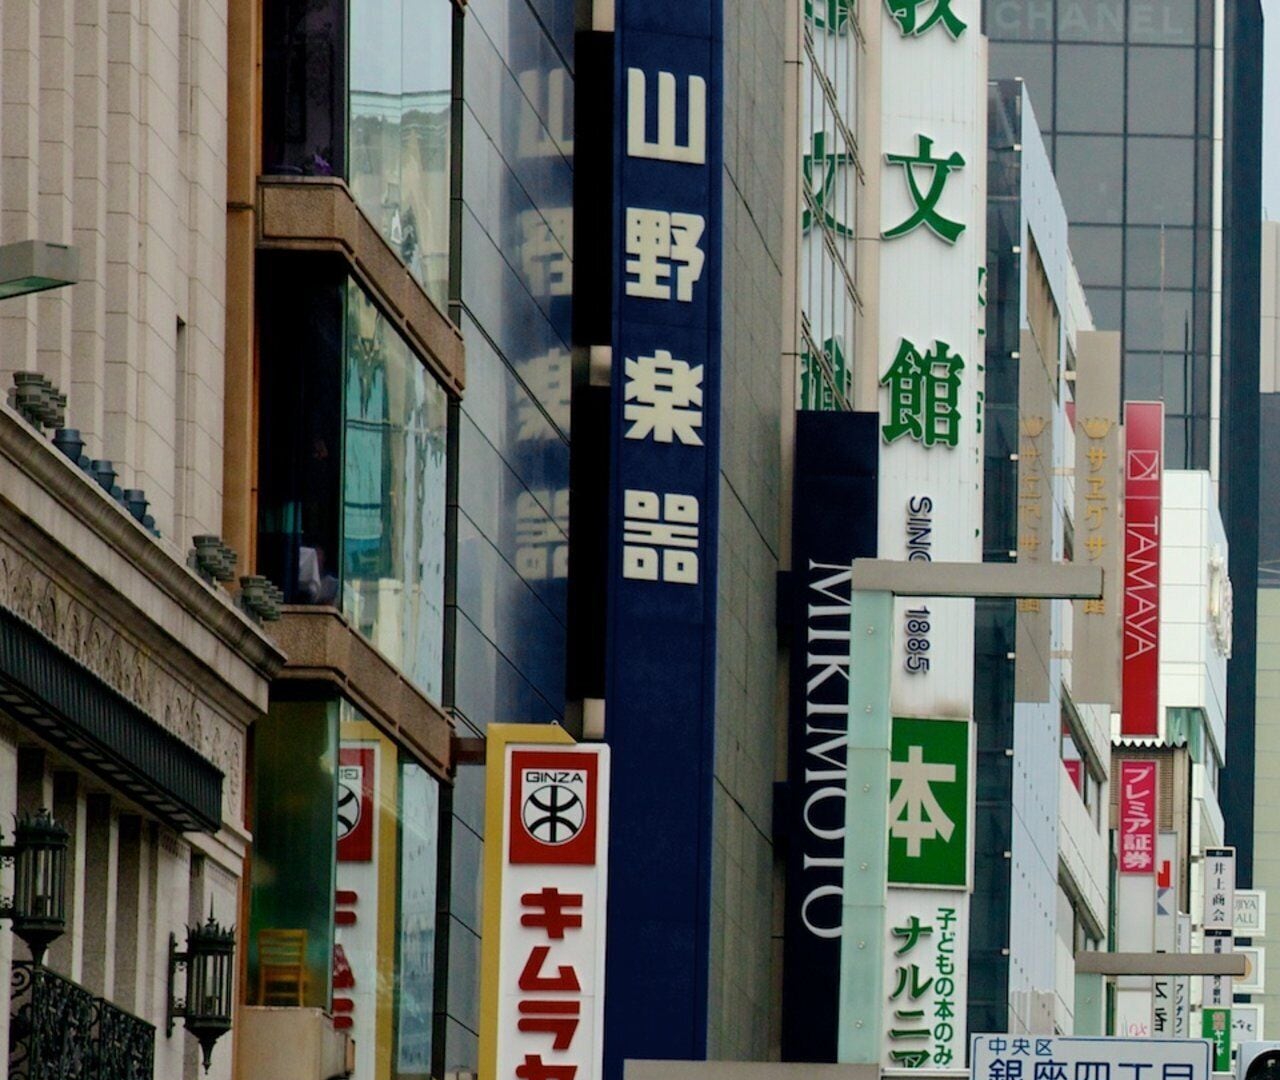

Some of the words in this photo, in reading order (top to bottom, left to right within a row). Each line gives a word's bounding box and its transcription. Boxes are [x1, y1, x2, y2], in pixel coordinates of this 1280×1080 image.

[623, 67, 706, 585] 山野楽器
[1126, 516, 1159, 660] TAMAYA
[526, 772, 584, 784] GINZA
[889, 746, 957, 858] 本
[1124, 766, 1153, 869] プレミア証券
[1212, 862, 1225, 923] 井上商会
[934, 908, 957, 1069] 子どもの本のみ
[988, 1039, 1055, 1056] 中央区
